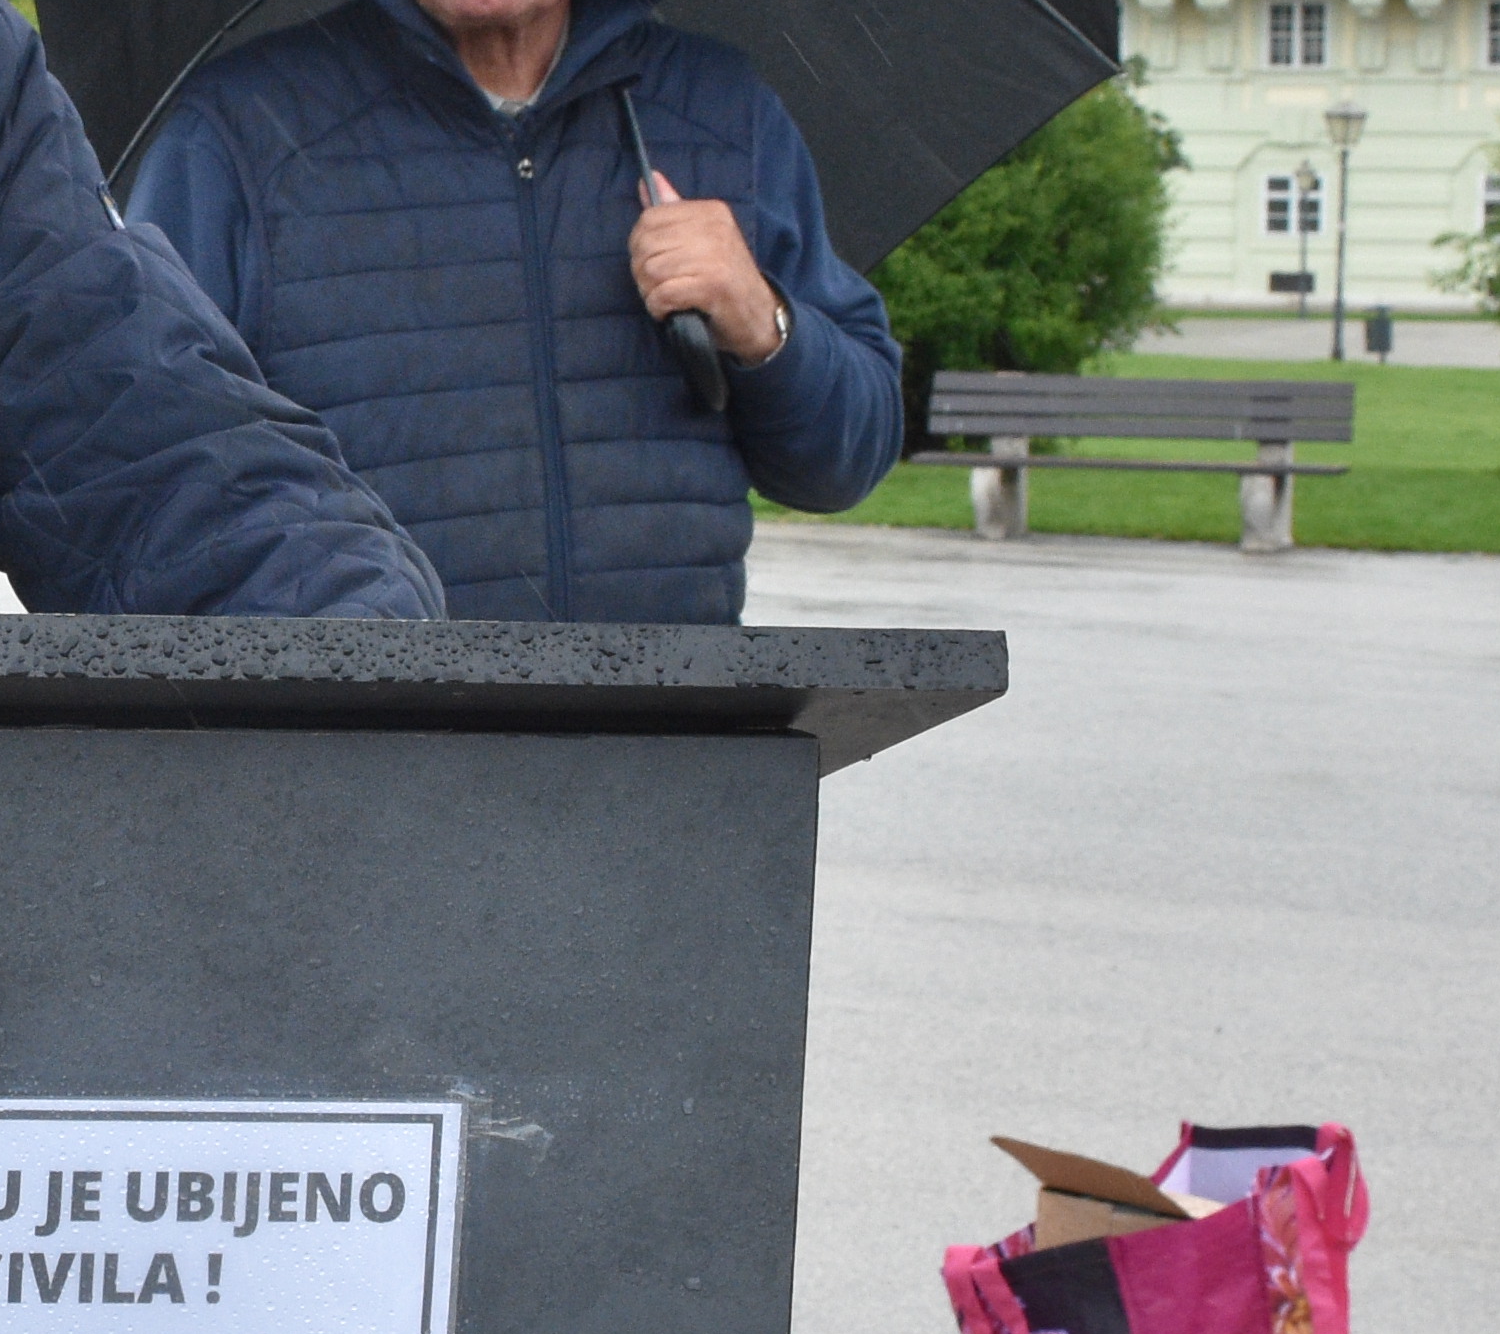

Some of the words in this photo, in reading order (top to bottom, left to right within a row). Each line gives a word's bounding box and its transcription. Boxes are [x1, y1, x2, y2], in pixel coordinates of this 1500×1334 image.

[34, 1170, 103, 1238] JE
[126, 1171, 406, 1238] UBIJENO
[205, 1253, 223, 1304] !
